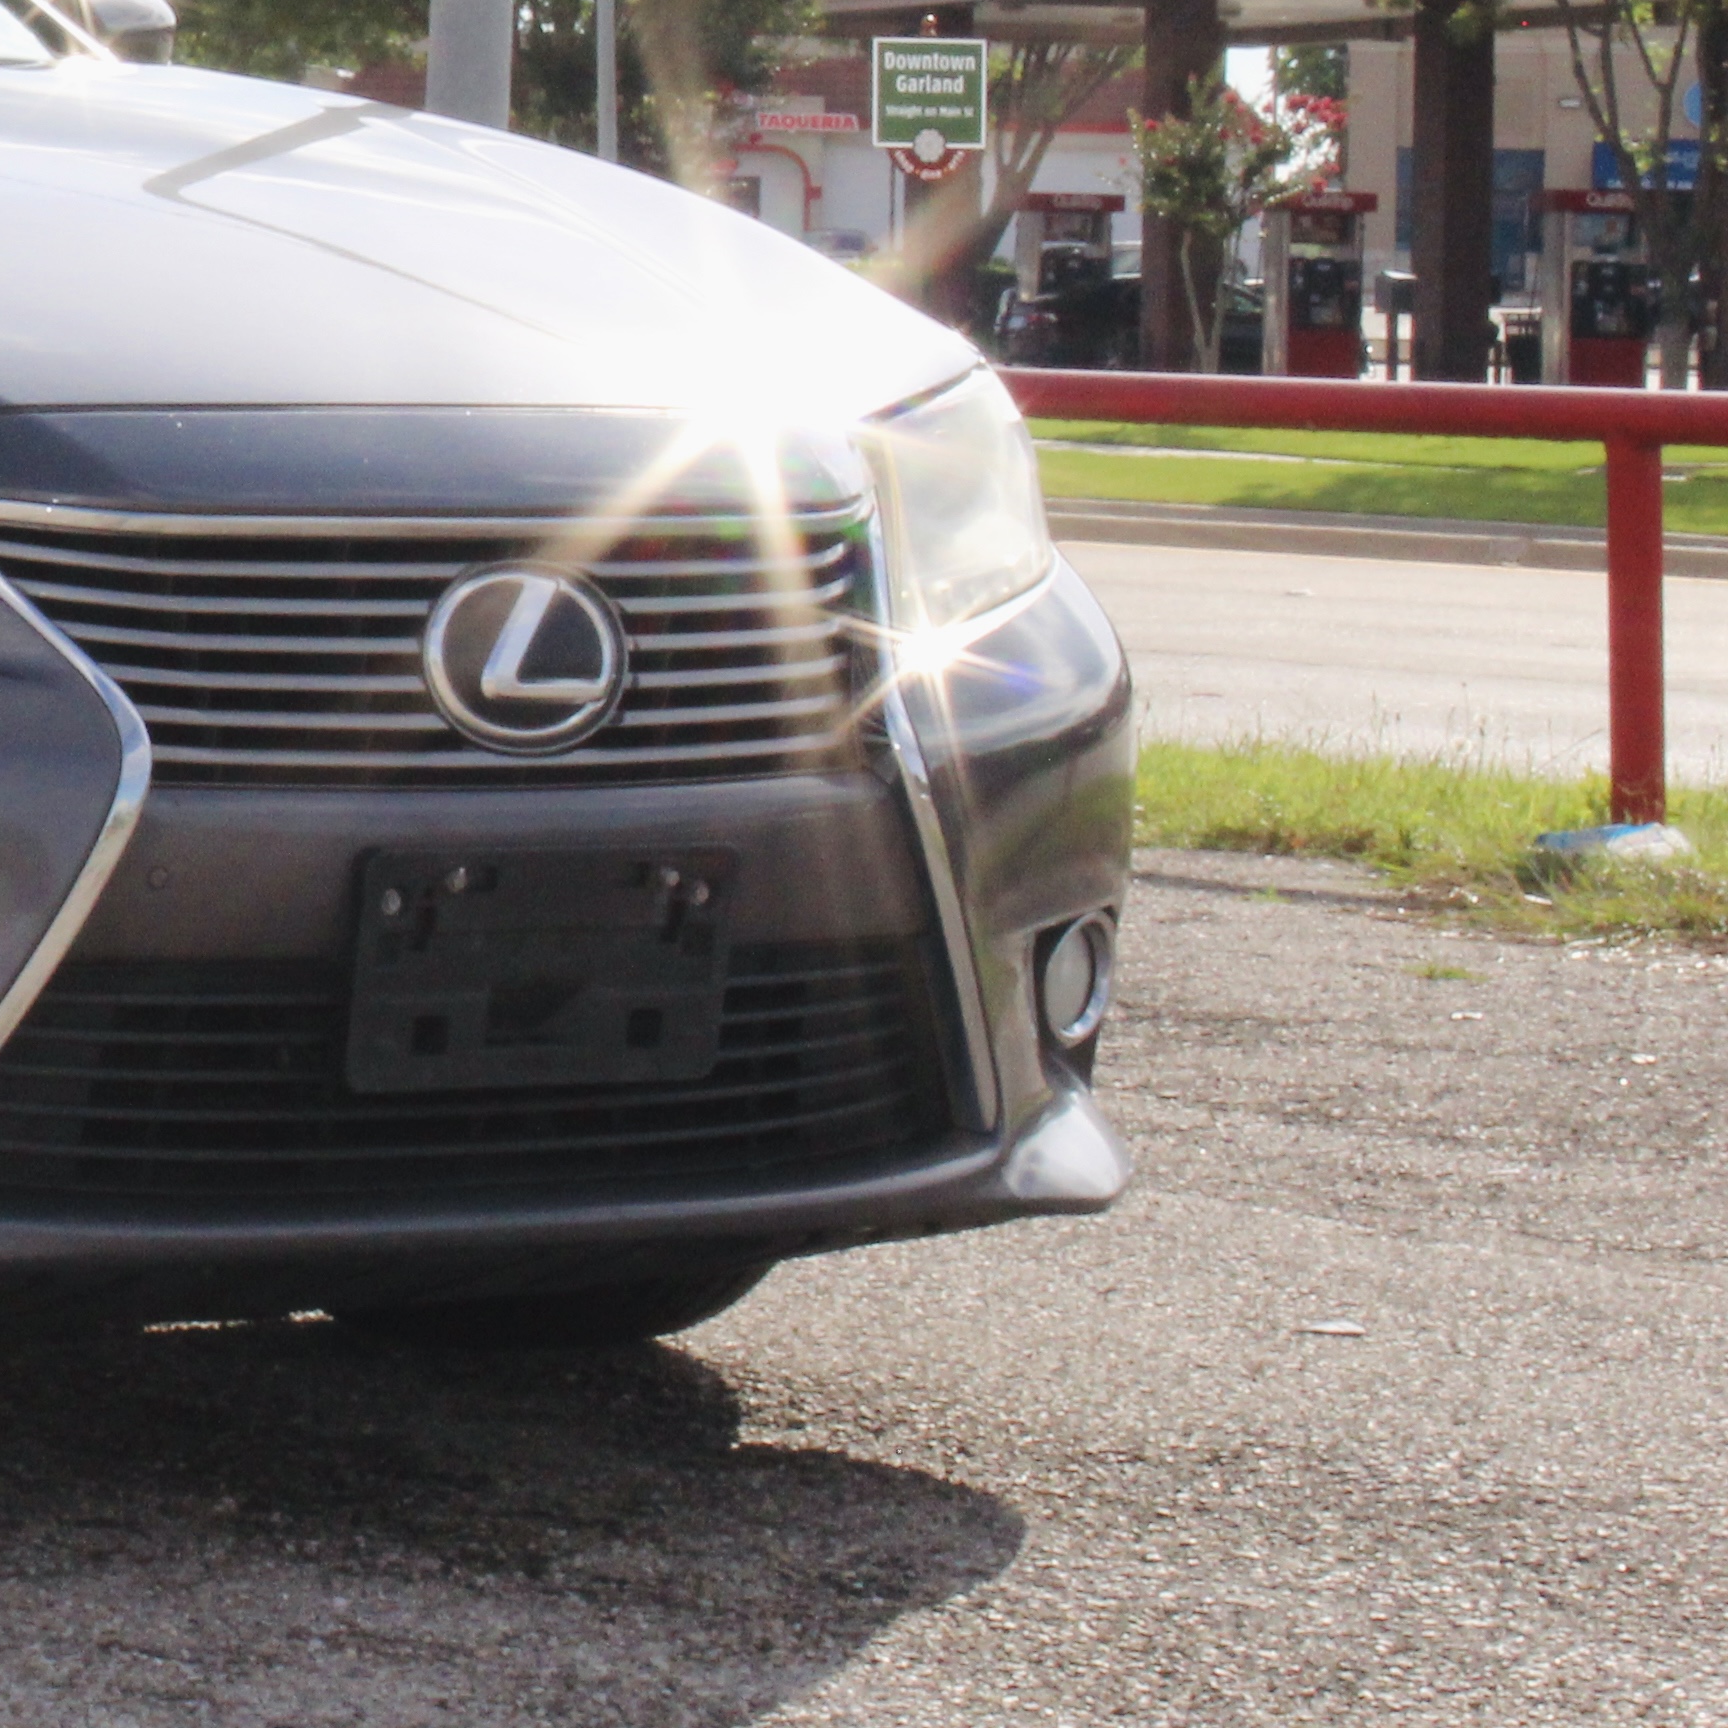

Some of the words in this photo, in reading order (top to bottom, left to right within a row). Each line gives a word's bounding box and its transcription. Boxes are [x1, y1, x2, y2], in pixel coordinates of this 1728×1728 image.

[884, 51, 976, 70] Downtown
[896, 74, 964, 93] Garland
[758, 113, 856, 130] TAQUERIA
